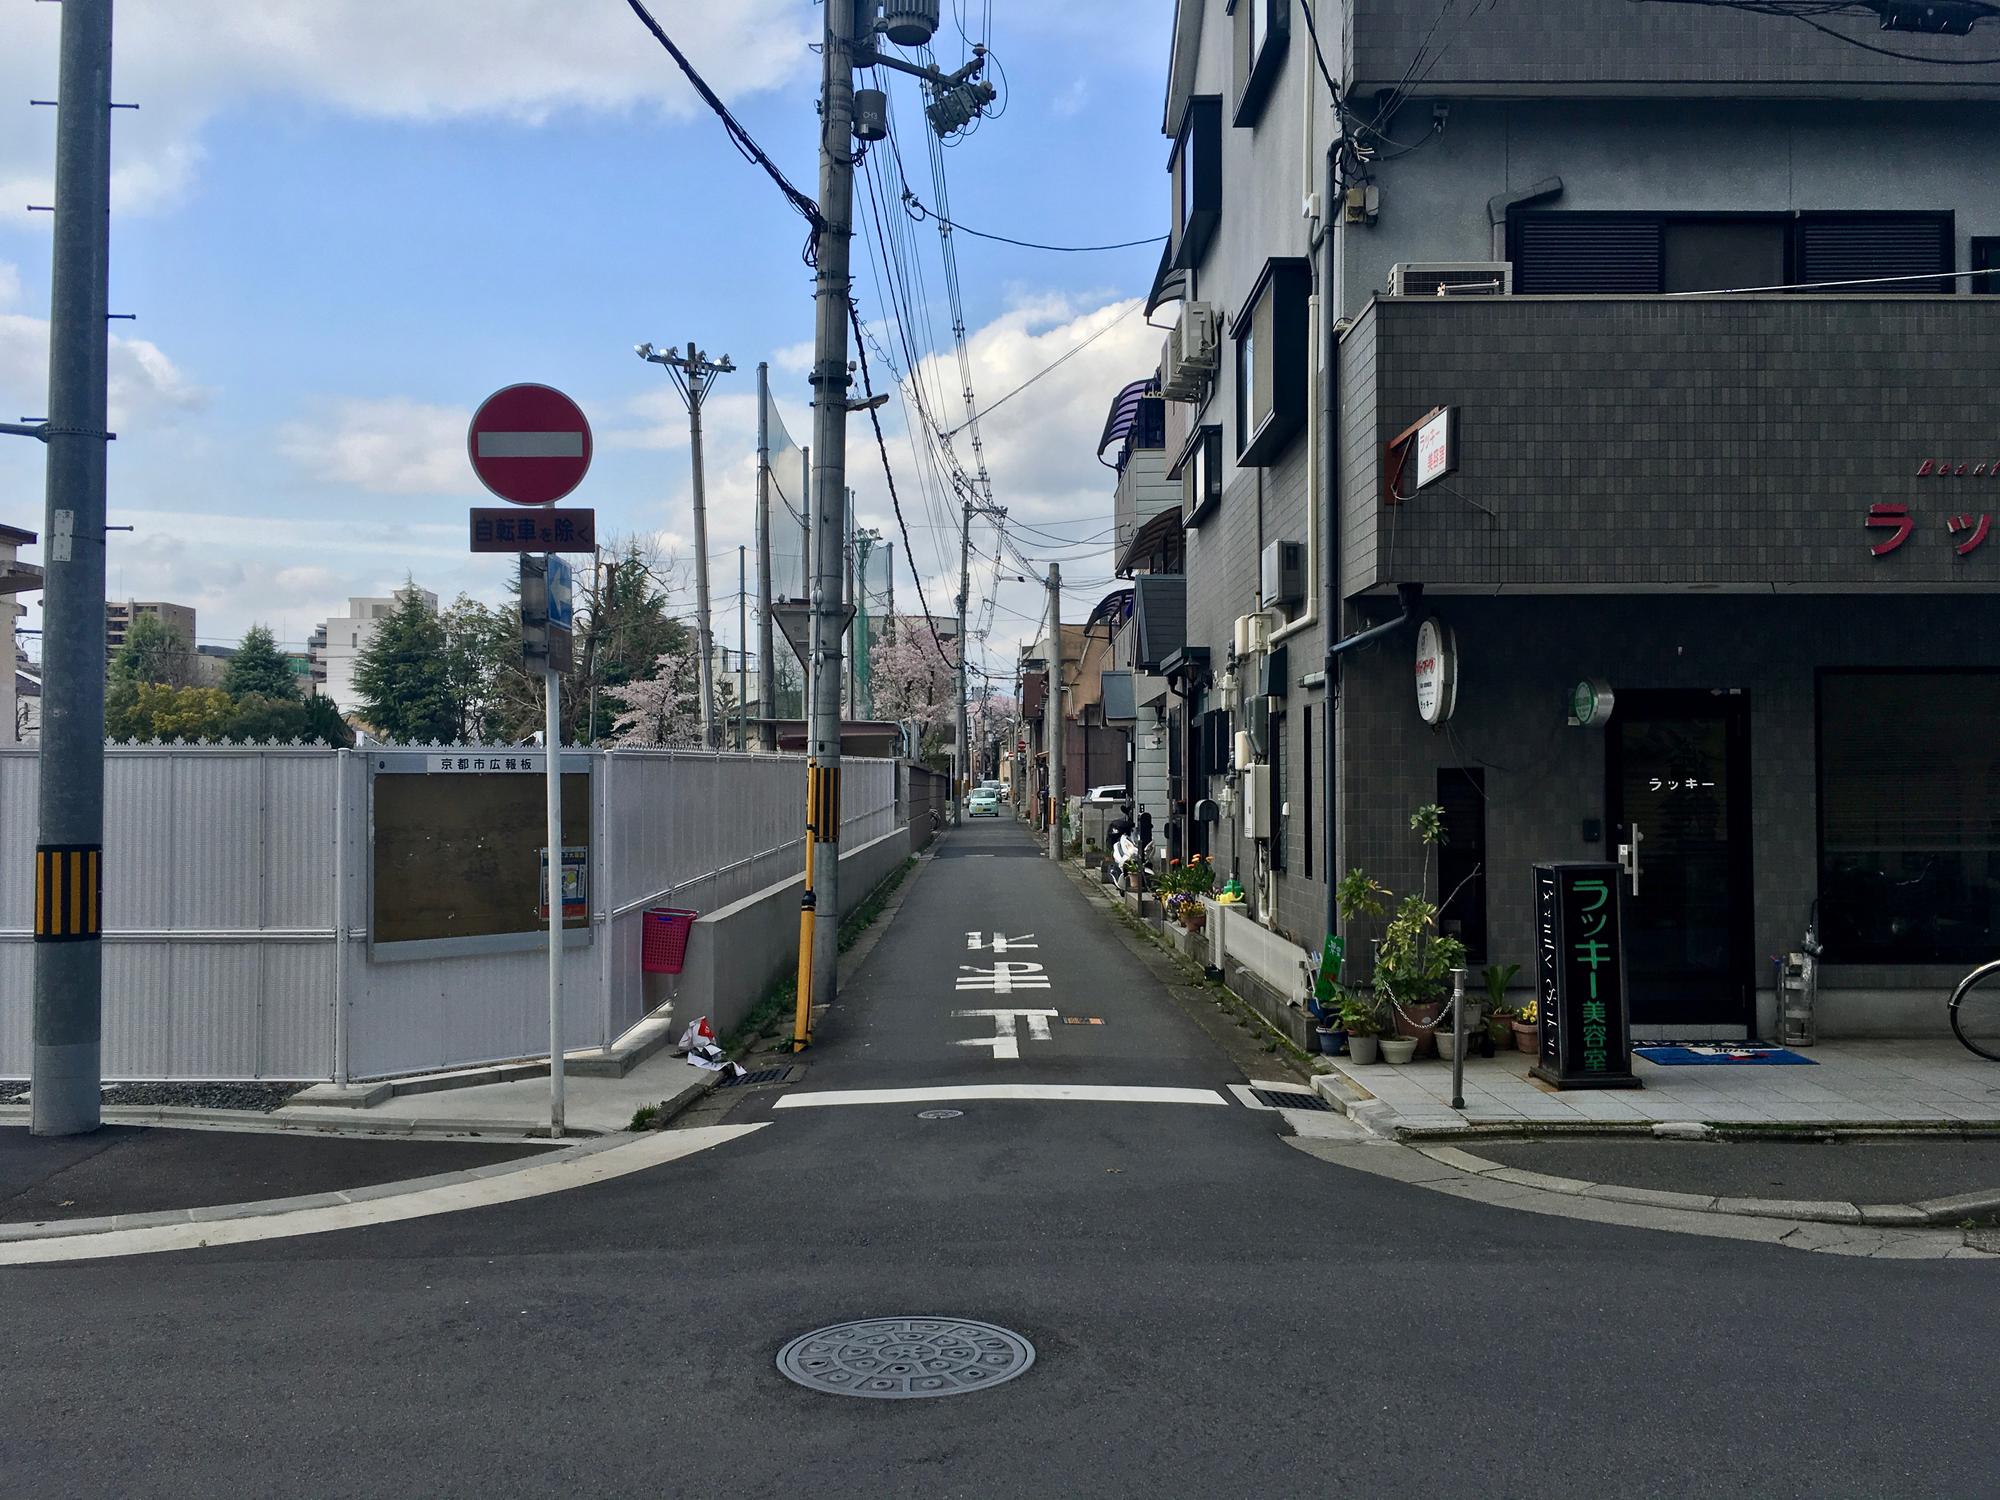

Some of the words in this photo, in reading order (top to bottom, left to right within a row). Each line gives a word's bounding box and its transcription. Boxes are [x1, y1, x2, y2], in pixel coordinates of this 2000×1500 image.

[475, 518, 589, 543] 自転車を除く
[440, 757, 533, 771] 京都市広報板
[1649, 777, 1715, 792] ラッキー
[948, 931, 1058, 1058] 止まれ
